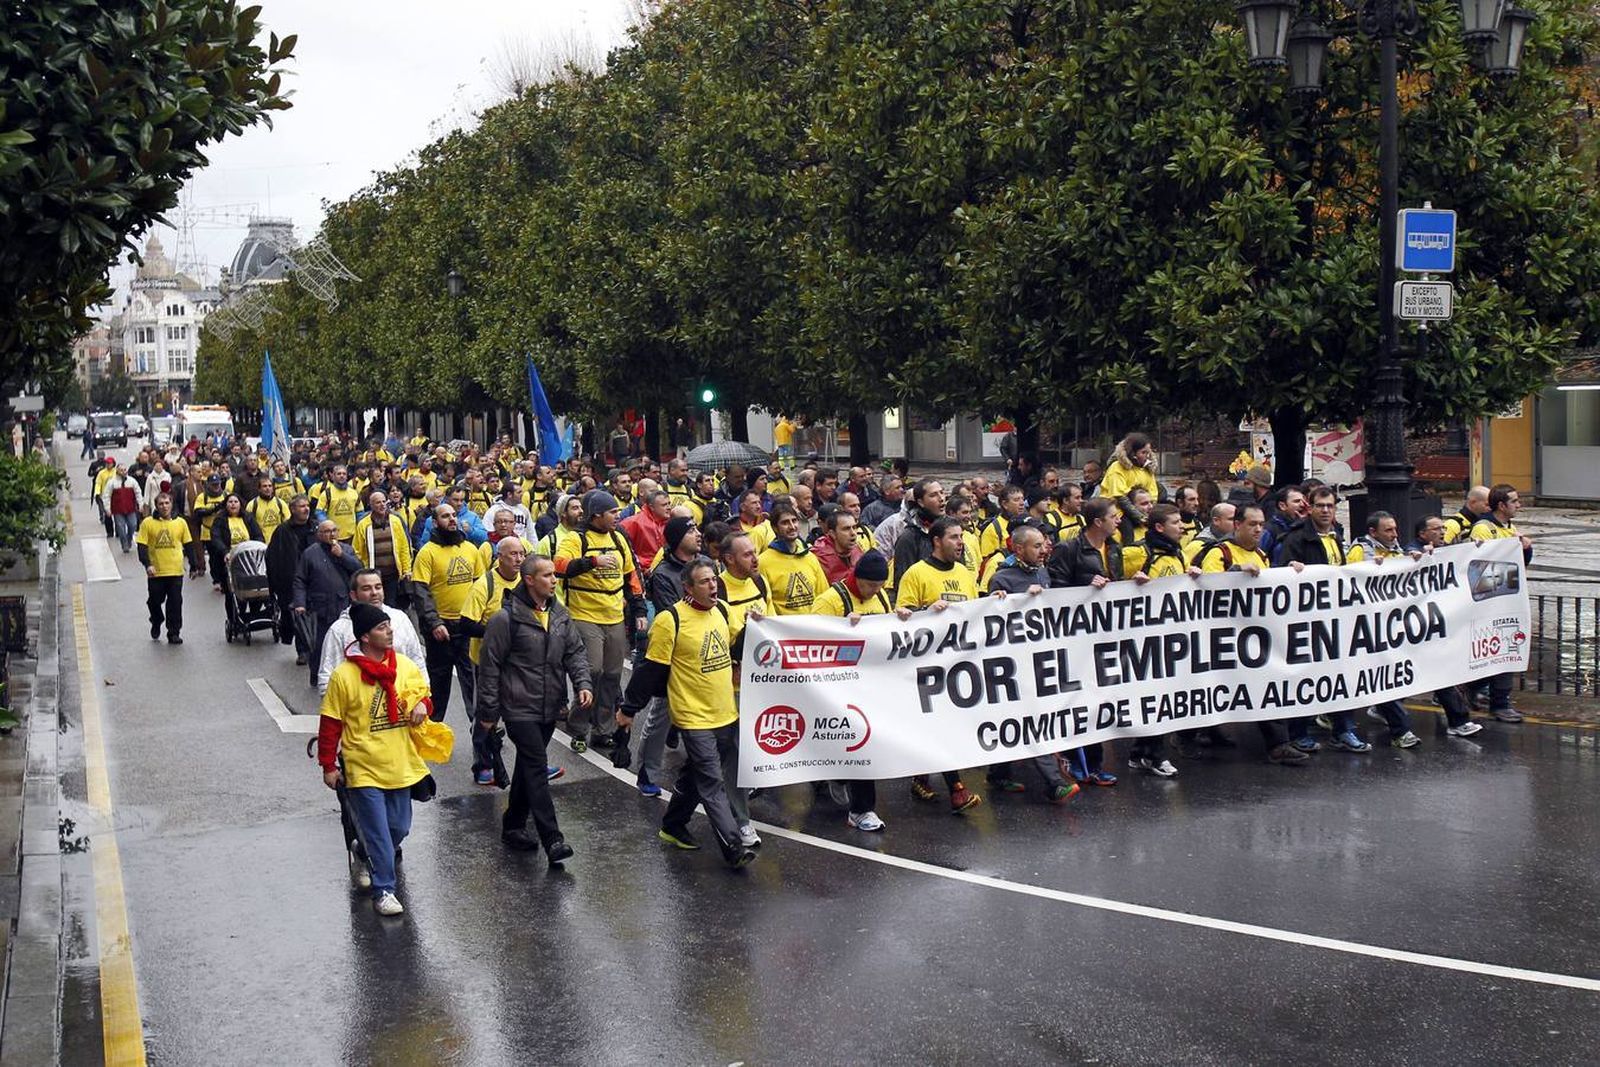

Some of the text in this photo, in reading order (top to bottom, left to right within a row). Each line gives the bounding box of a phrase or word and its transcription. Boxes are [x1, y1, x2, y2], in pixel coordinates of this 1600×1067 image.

[1412, 287, 1437, 295] EXCEPTO
[1405, 297, 1417, 306] BUS
[1404, 307, 1444, 316] TAXI Y MOTOS
[887, 561, 1459, 661] NO AL DESMANTELAMIENTO DE LA INDUSTRIA
[1492, 617, 1520, 626] ESTATAL
[783, 645, 839, 663] CCOO
[1472, 636, 1501, 659] USO
[916, 601, 1447, 713] POR EL EMPLEO EN ALCOA
[812, 673, 822, 683] de
[822, 670, 860, 683] industria
[978, 660, 1415, 752] COMITE DE FABRICA ALCOA AVILES
[761, 712, 800, 733] UGT
[814, 717, 851, 730] MCA
[812, 731, 857, 741] Asturias
[780, 759, 836, 771] CONSTRUCCIÓN
